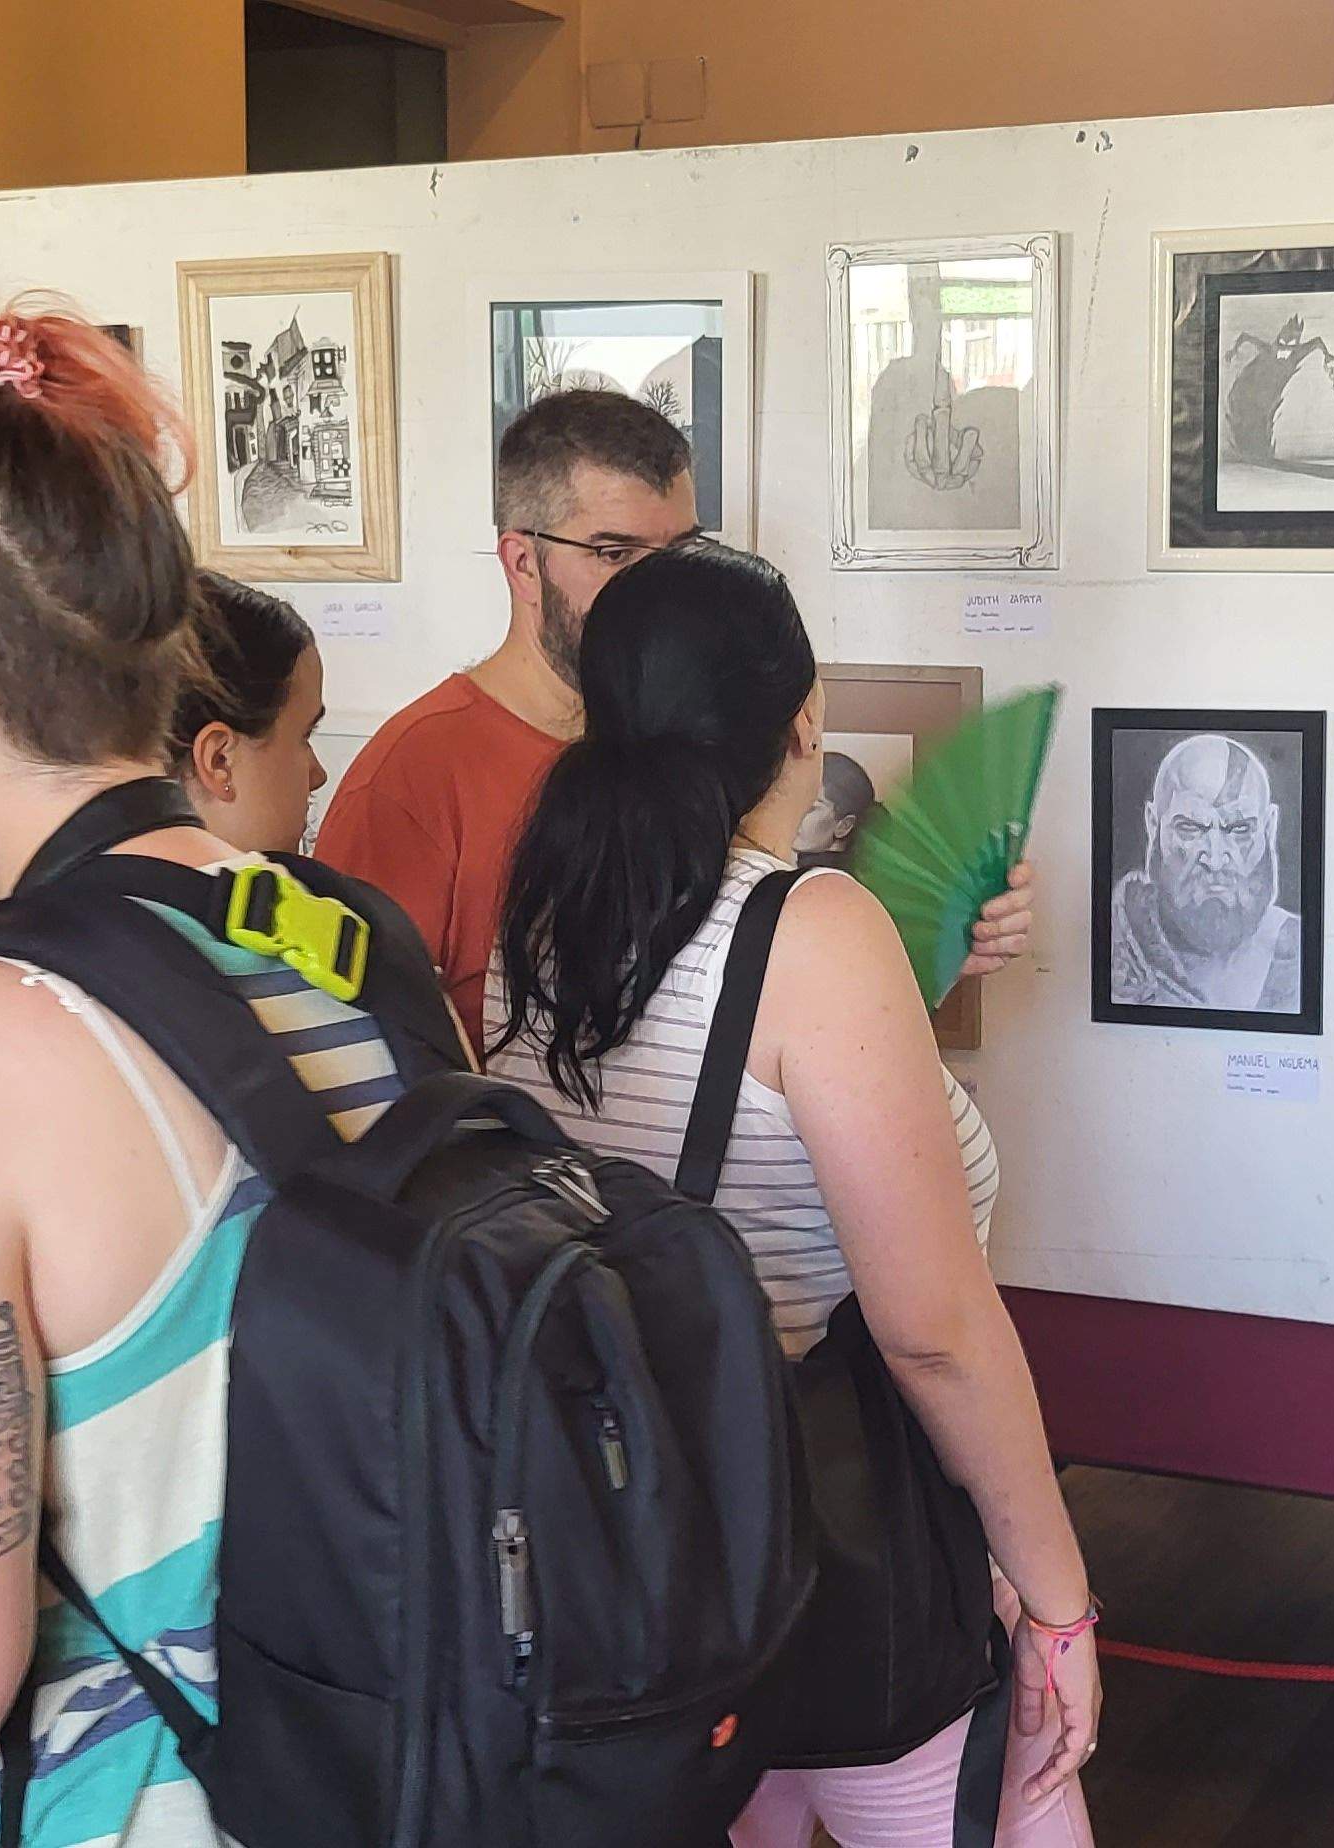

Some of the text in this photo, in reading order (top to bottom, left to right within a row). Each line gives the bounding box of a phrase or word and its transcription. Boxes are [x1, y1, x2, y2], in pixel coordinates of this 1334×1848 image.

[967, 594, 1042, 606] JUDITH ZAPATA
[1227, 1054, 1320, 1072] MANUEL NGUEMA
